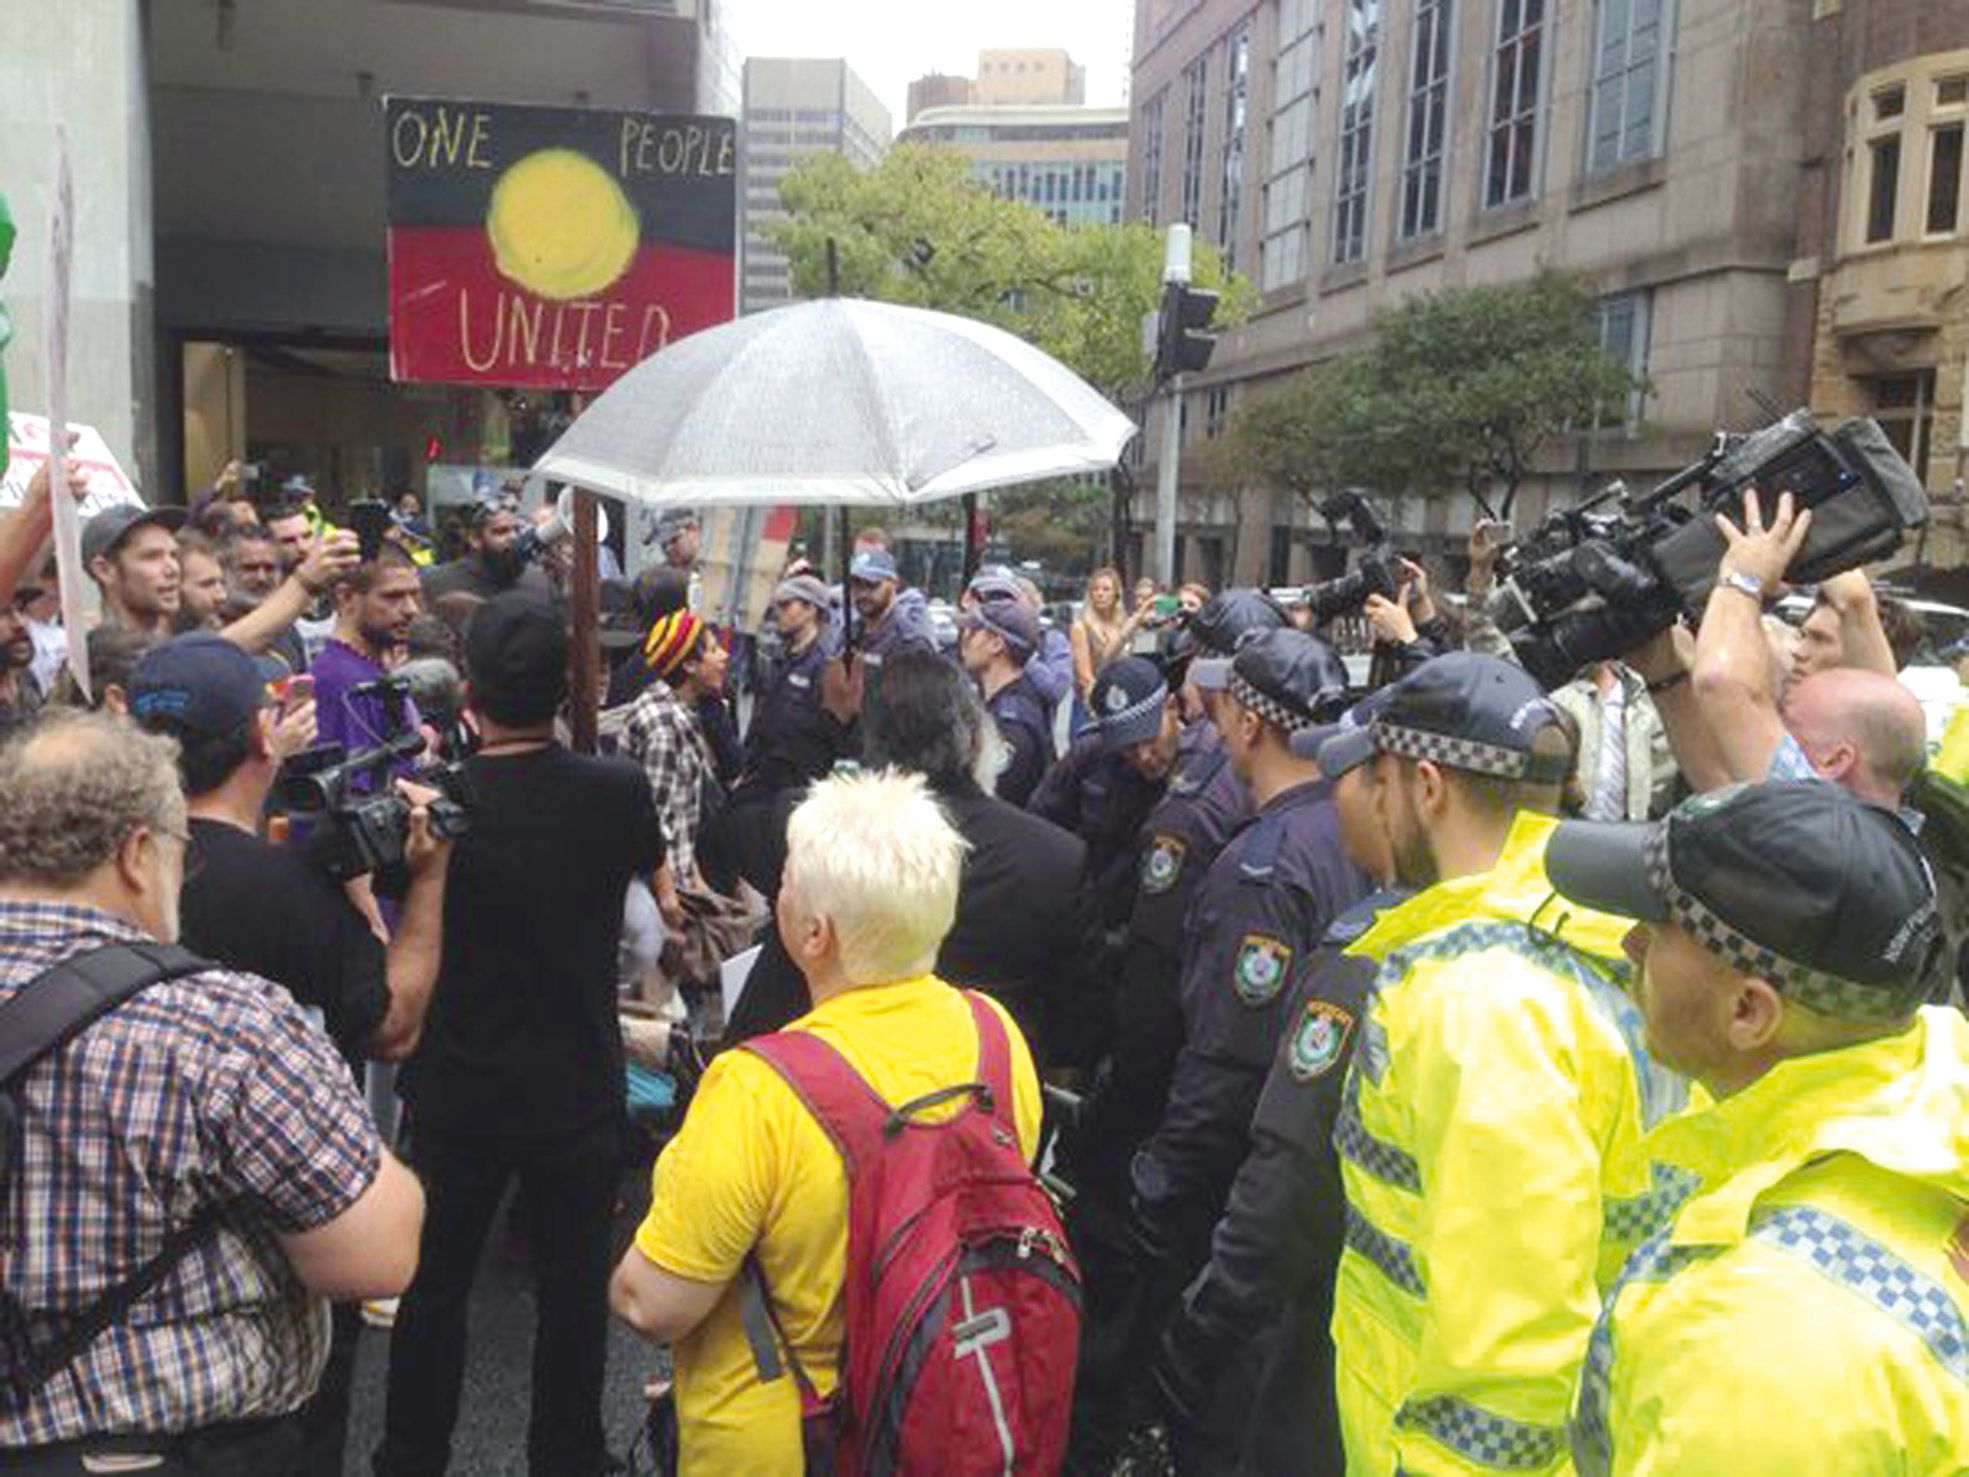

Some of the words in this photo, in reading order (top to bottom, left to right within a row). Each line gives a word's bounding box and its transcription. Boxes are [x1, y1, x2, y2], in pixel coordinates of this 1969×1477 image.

[393, 107, 492, 168] ONE
[619, 116, 735, 176] PEOPLE
[460, 288, 670, 371] UNITED
